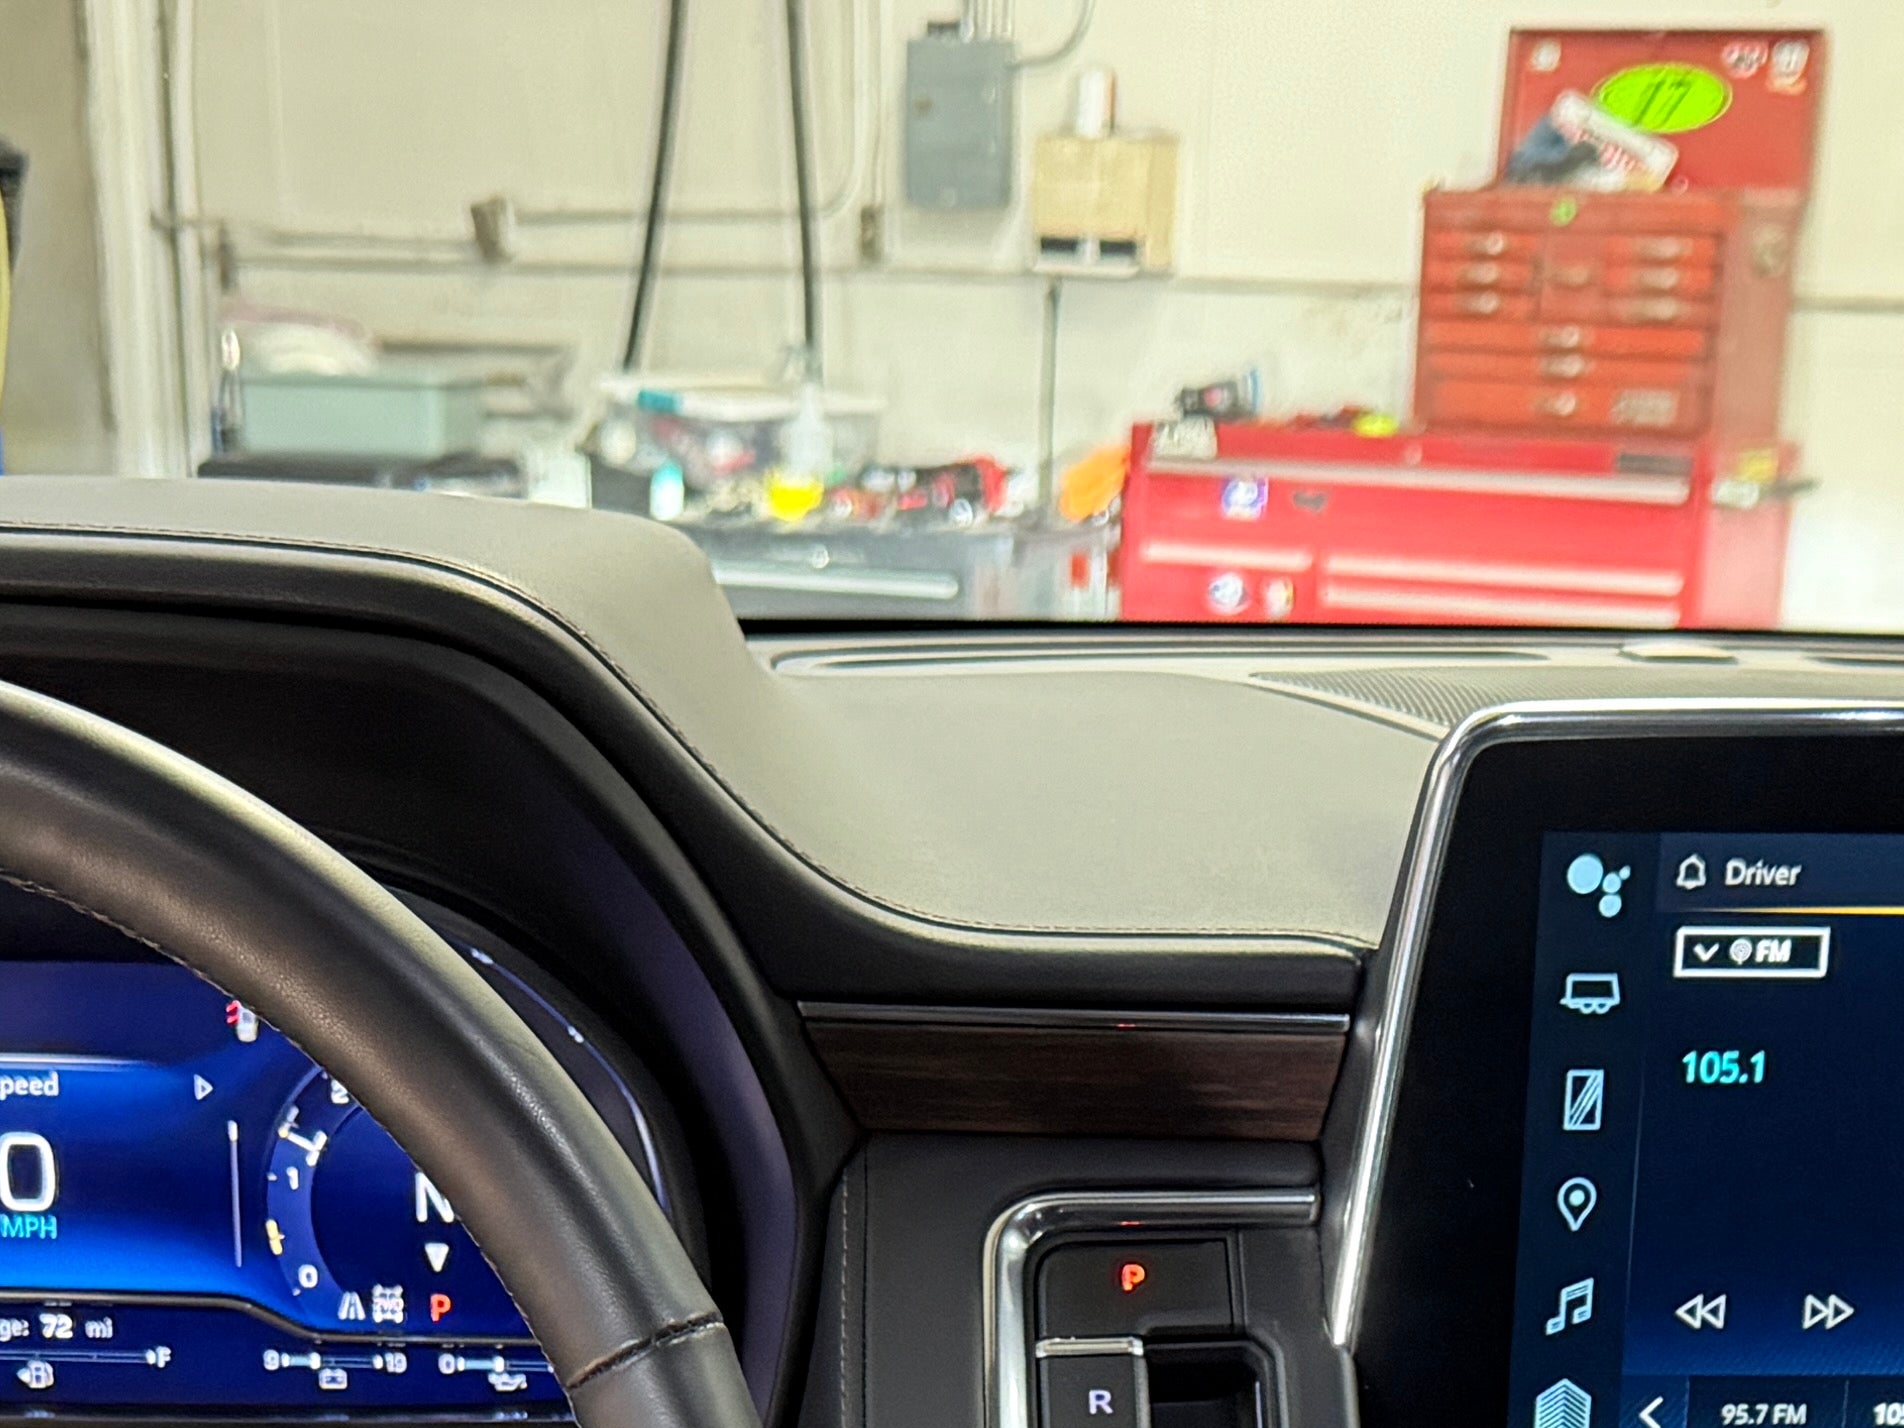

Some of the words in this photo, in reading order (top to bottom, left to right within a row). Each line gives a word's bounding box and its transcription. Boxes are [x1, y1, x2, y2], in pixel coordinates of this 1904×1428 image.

[1724, 858, 1802, 886] Driver
[1754, 938, 1793, 963] FM
[1682, 1049, 1767, 1085] 105.1
[298, 1264, 319, 1289] 0
[1119, 1262, 1146, 1292] P
[430, 1293, 452, 1322] P
[38, 1313, 74, 1339] 72
[84, 1316, 114, 1339] mi
[155, 1344, 172, 1368] F
[1087, 1389, 1114, 1415] R
[1721, 1402, 1769, 1426] 95.7
[1771, 1402, 1807, 1426] FM
